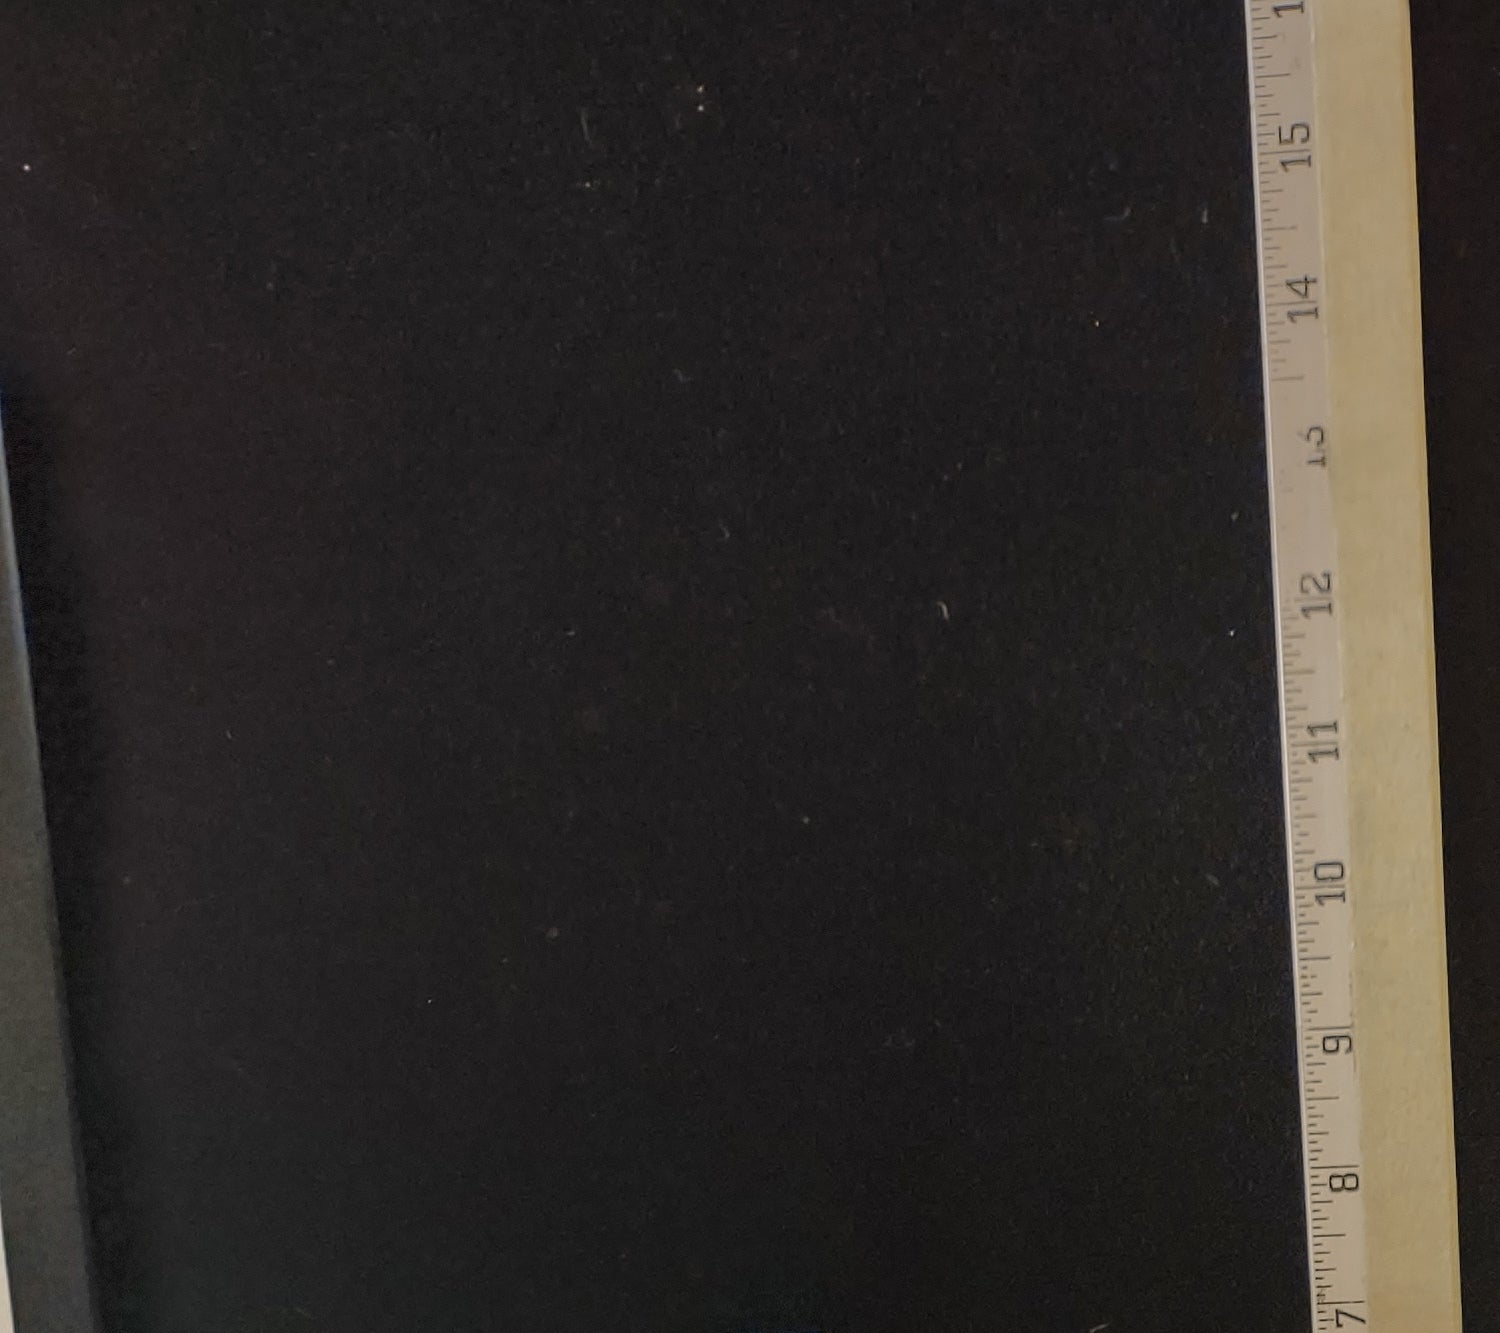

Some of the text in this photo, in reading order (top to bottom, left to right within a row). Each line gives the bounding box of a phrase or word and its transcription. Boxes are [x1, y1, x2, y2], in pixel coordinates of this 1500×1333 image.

[1278, 121, 1312, 173] 15
[1285, 274, 1319, 325] 14
[1300, 570, 1333, 620] 12
[1306, 719, 1340, 764] 11
[1314, 861, 1346, 907] 10
[1322, 1034, 1353, 1055] 9
[1328, 1172, 1359, 1193] 8
[1335, 1308, 1367, 1329] 7
